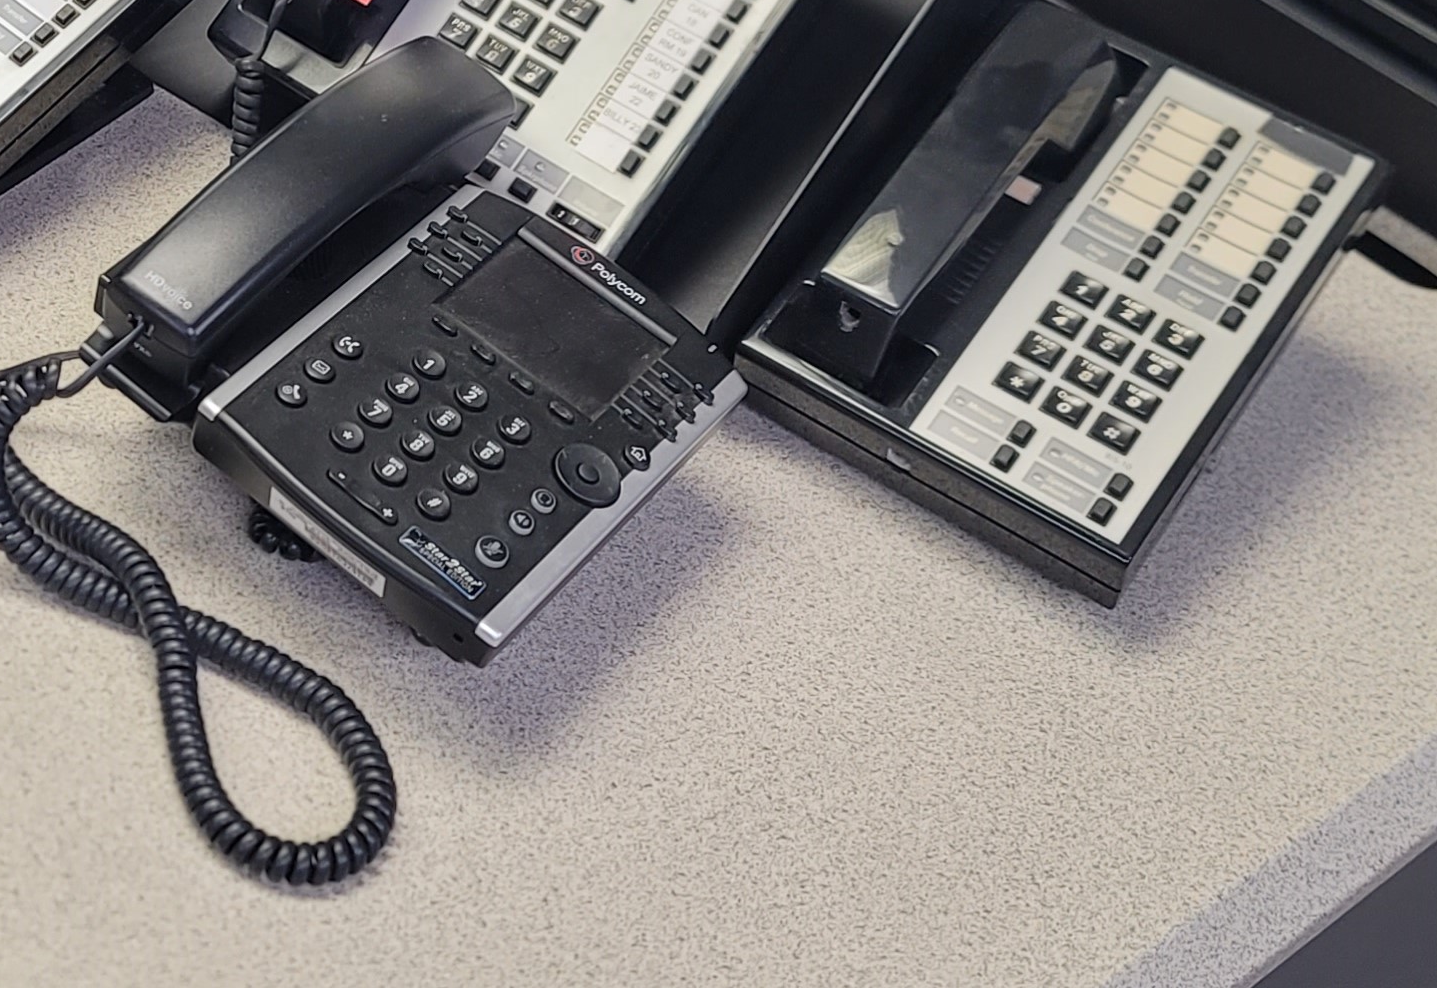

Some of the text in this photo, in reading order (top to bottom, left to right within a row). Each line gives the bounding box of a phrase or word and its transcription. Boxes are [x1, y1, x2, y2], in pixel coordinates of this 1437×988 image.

[513, 9, 529, 20] JKL
[568, 7, 582, 17] 3
[452, 18, 471, 32] PRS
[448, 29, 462, 38] 7
[549, 28, 570, 42] MNO
[665, 26, 693, 47] CONF
[489, 39, 508, 52] TUV
[546, 40, 559, 49] 6
[644, 52, 678, 75] SANDY
[524, 70, 537, 81] 9
[629, 82, 658, 100] JAIME
[629, 96, 642, 106] 22
[604, 108, 629, 127] BILLY
[590, 262, 646, 305] Polycom
[1119, 309, 1136, 320] 2
[1033, 335, 1056, 350] PRS
[1167, 334, 1184, 345] 3
[1031, 345, 1046, 355] 7
[423, 360, 435, 370] 1
[395, 382, 408, 394] 4
[463, 391, 478, 403] 2
[367, 405, 382, 416] 7
[1056, 403, 1072, 412] 0
[437, 415, 449, 426] 5
[506, 422, 520, 435] 3
[410, 439, 424, 451] 8
[480, 447, 493, 459] 6
[382, 464, 396, 476] 0
[453, 472, 467, 484] 9
[419, 547, 473, 593] SPECIAL EDITION
[425, 542, 483, 587] Star2Star
